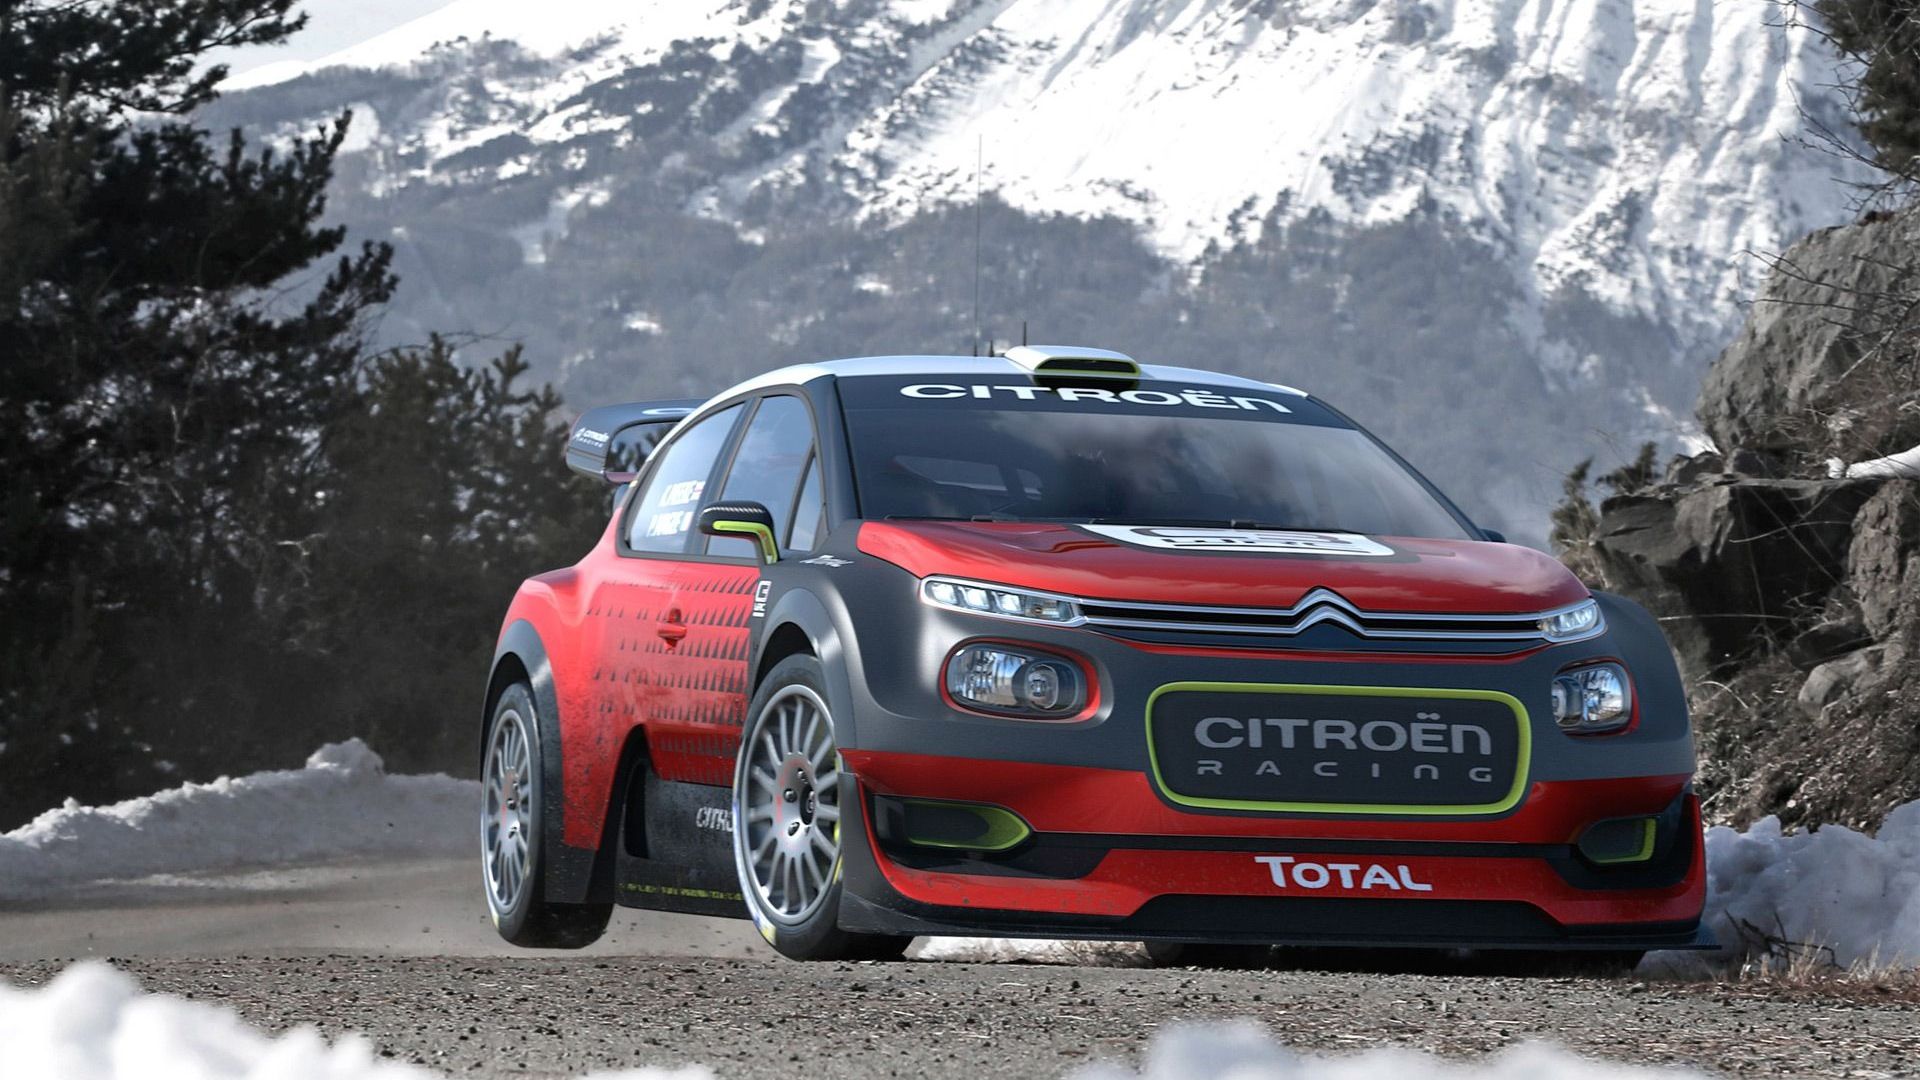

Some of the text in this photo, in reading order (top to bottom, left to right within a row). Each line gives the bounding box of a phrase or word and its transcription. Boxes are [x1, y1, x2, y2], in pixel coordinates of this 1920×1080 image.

[1195, 712, 1492, 755] CITROËN
[1197, 760, 1493, 783] RACING
[1254, 856, 1433, 891] TOTAL
